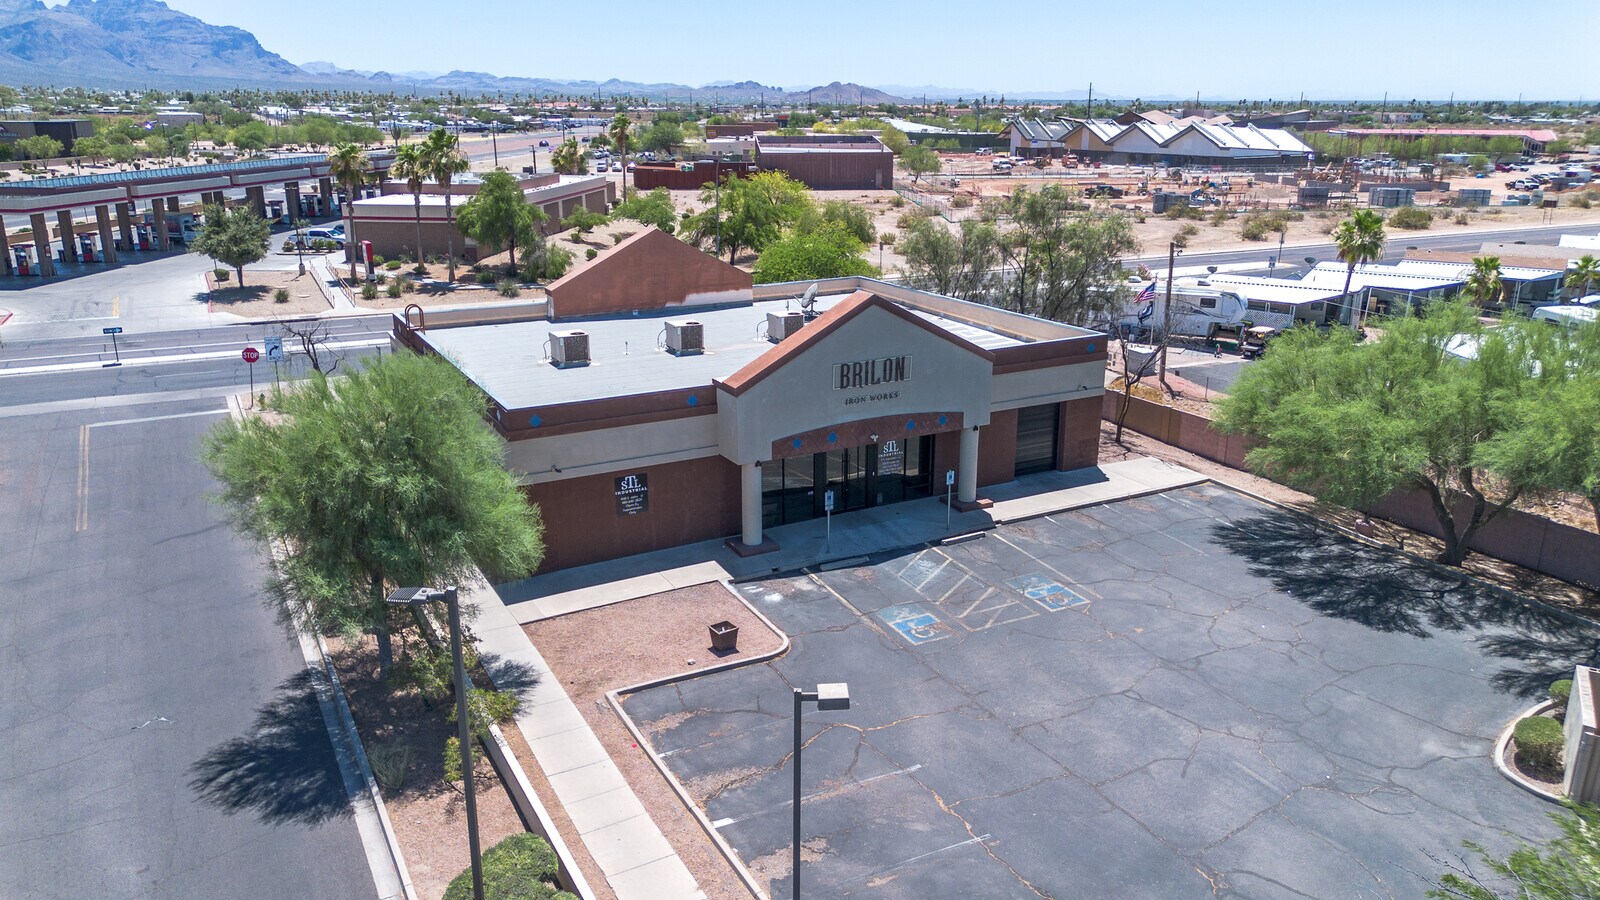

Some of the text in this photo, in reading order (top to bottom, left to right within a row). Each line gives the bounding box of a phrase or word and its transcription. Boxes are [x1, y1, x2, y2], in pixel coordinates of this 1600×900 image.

[243, 351, 259, 359] STOP
[840, 356, 905, 389] BRILON
[844, 391, 899, 405] IRON WORKS
[883, 440, 899, 453] STL
[621, 475, 641, 490] STL
[615, 487, 647, 496] INDUSTRIAL
